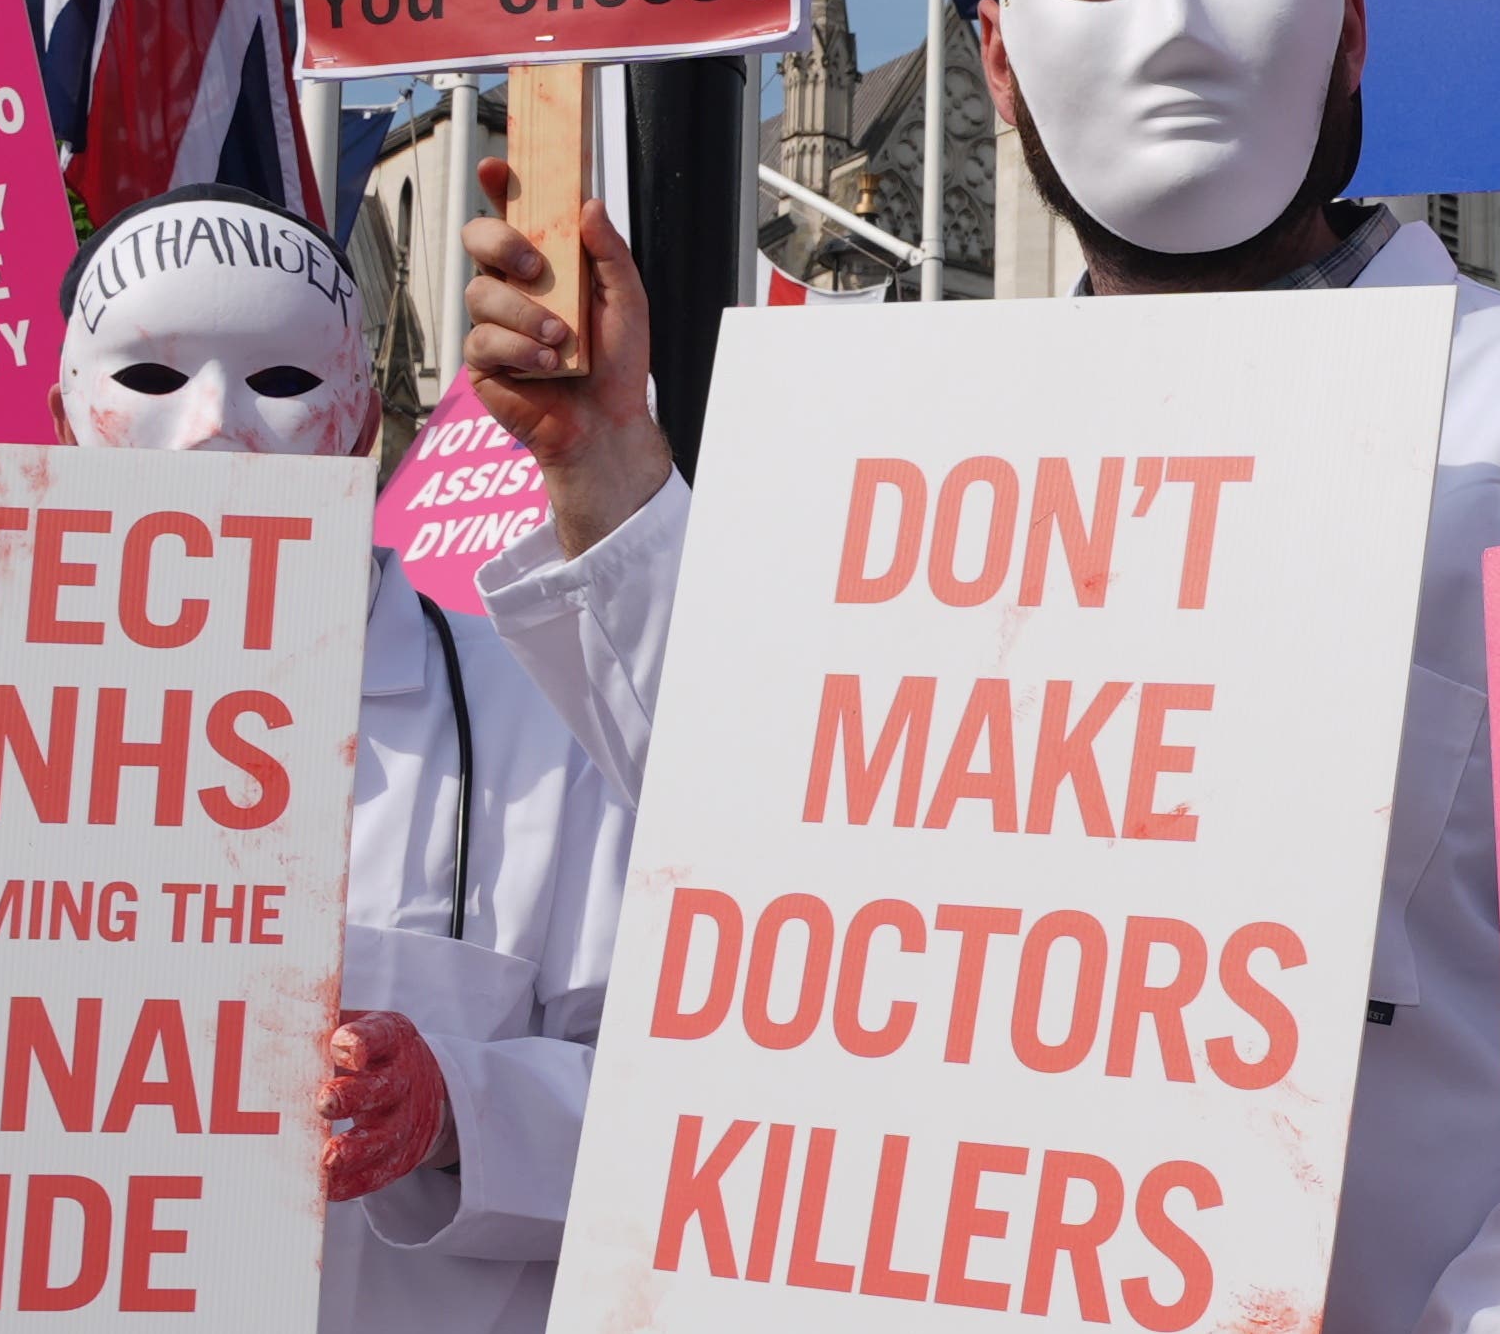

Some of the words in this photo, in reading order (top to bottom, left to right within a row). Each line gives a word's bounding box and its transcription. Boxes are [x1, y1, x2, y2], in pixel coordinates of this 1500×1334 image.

[78, 217, 353, 335] EUTHANISER
[418, 416, 508, 460] VOTE
[835, 456, 1255, 609] DON'T
[803, 674, 1215, 842] MAKE
[162, 883, 287, 945] THE
[650, 887, 1308, 1090] DOCTORS
[653, 1114, 1224, 1333] KILLERS
